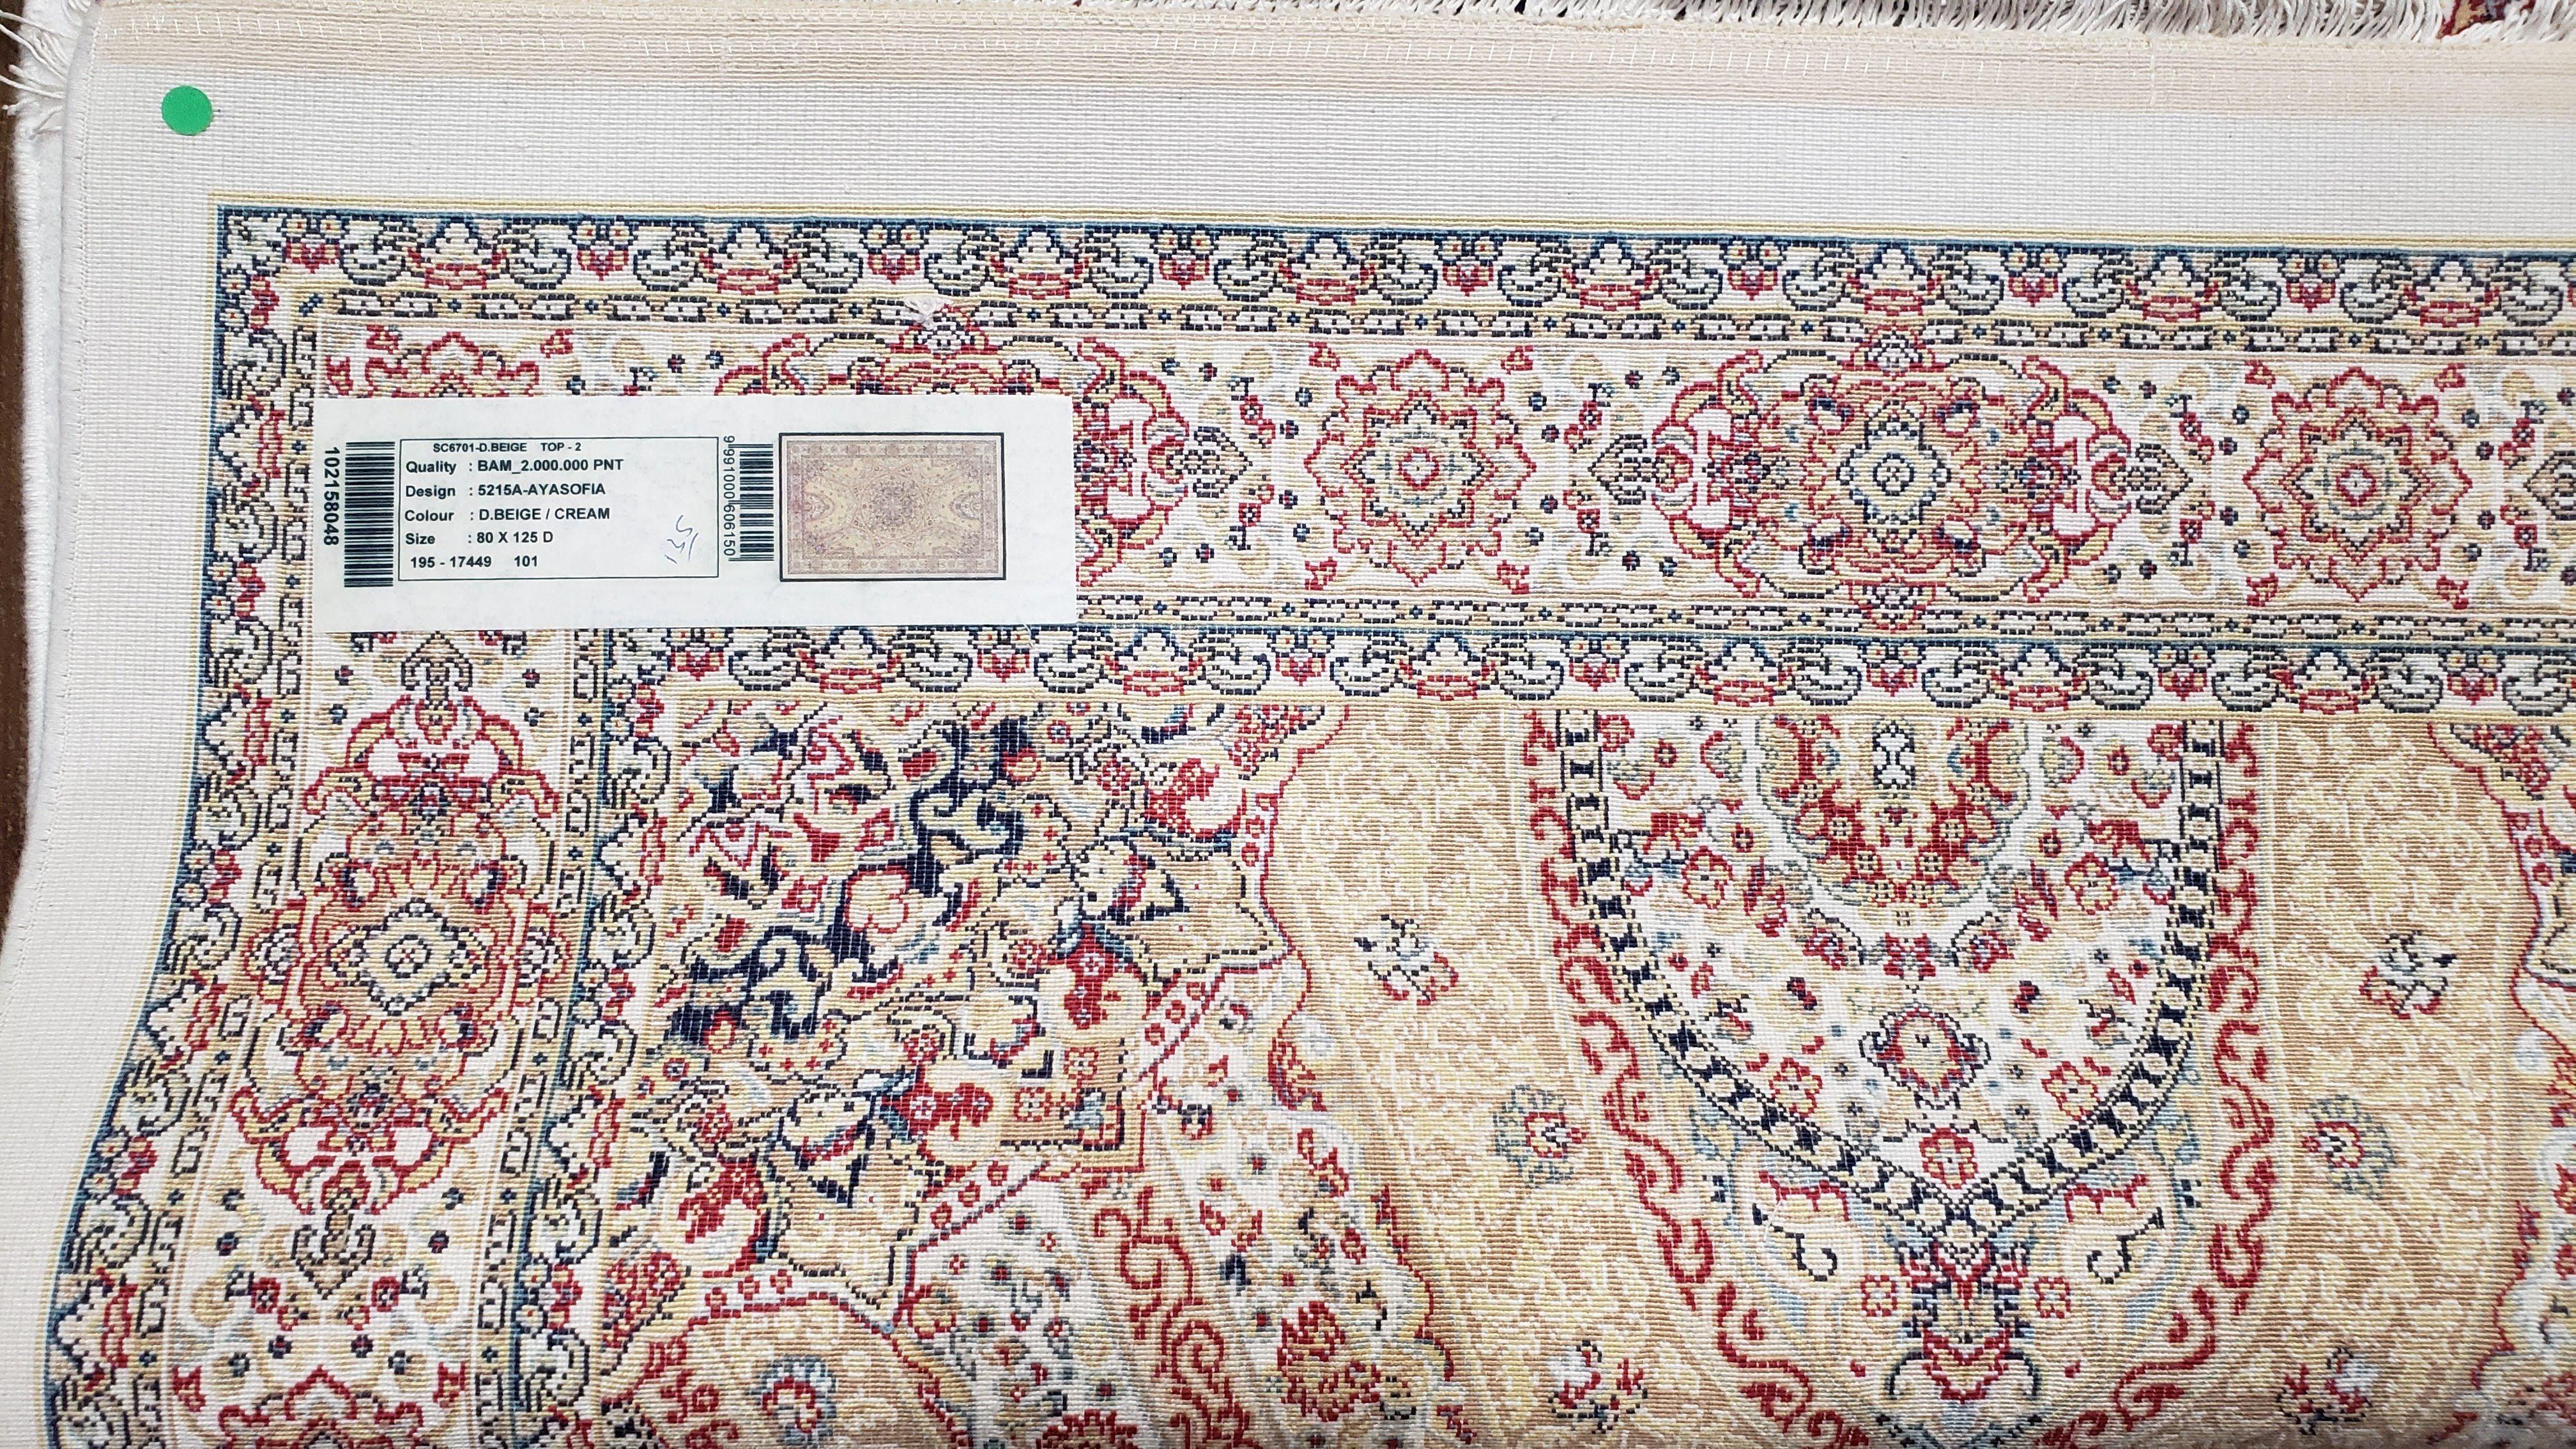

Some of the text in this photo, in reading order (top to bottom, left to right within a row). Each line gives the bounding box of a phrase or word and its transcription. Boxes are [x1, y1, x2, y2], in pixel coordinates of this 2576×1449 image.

[433, 442, 527, 453] SC6701-D.BEIGE
[540, 442, 565, 452] TOP
[575, 442, 581, 452] 2
[406, 460, 457, 475] Quality
[477, 459, 588, 475] BAM_2.000.000
[594, 459, 624, 471] PNT
[323, 447, 341, 546] 102158048
[406, 484, 456, 500] Design
[478, 482, 606, 496] 5215A-AYASOFIA
[404, 509, 455, 522] Colour
[479, 508, 541, 521] D.BEIGE
[545, 508, 551, 520] /
[555, 507, 610, 520] CREAM
[405, 532, 436, 545] Size
[477, 532, 494, 544] 80
[498, 531, 509, 544] X
[513, 531, 538, 543] 125
[543, 531, 553, 543] D
[410, 556, 435, 569] 195
[450, 555, 492, 568] 17449
[514, 555, 537, 567] 101
